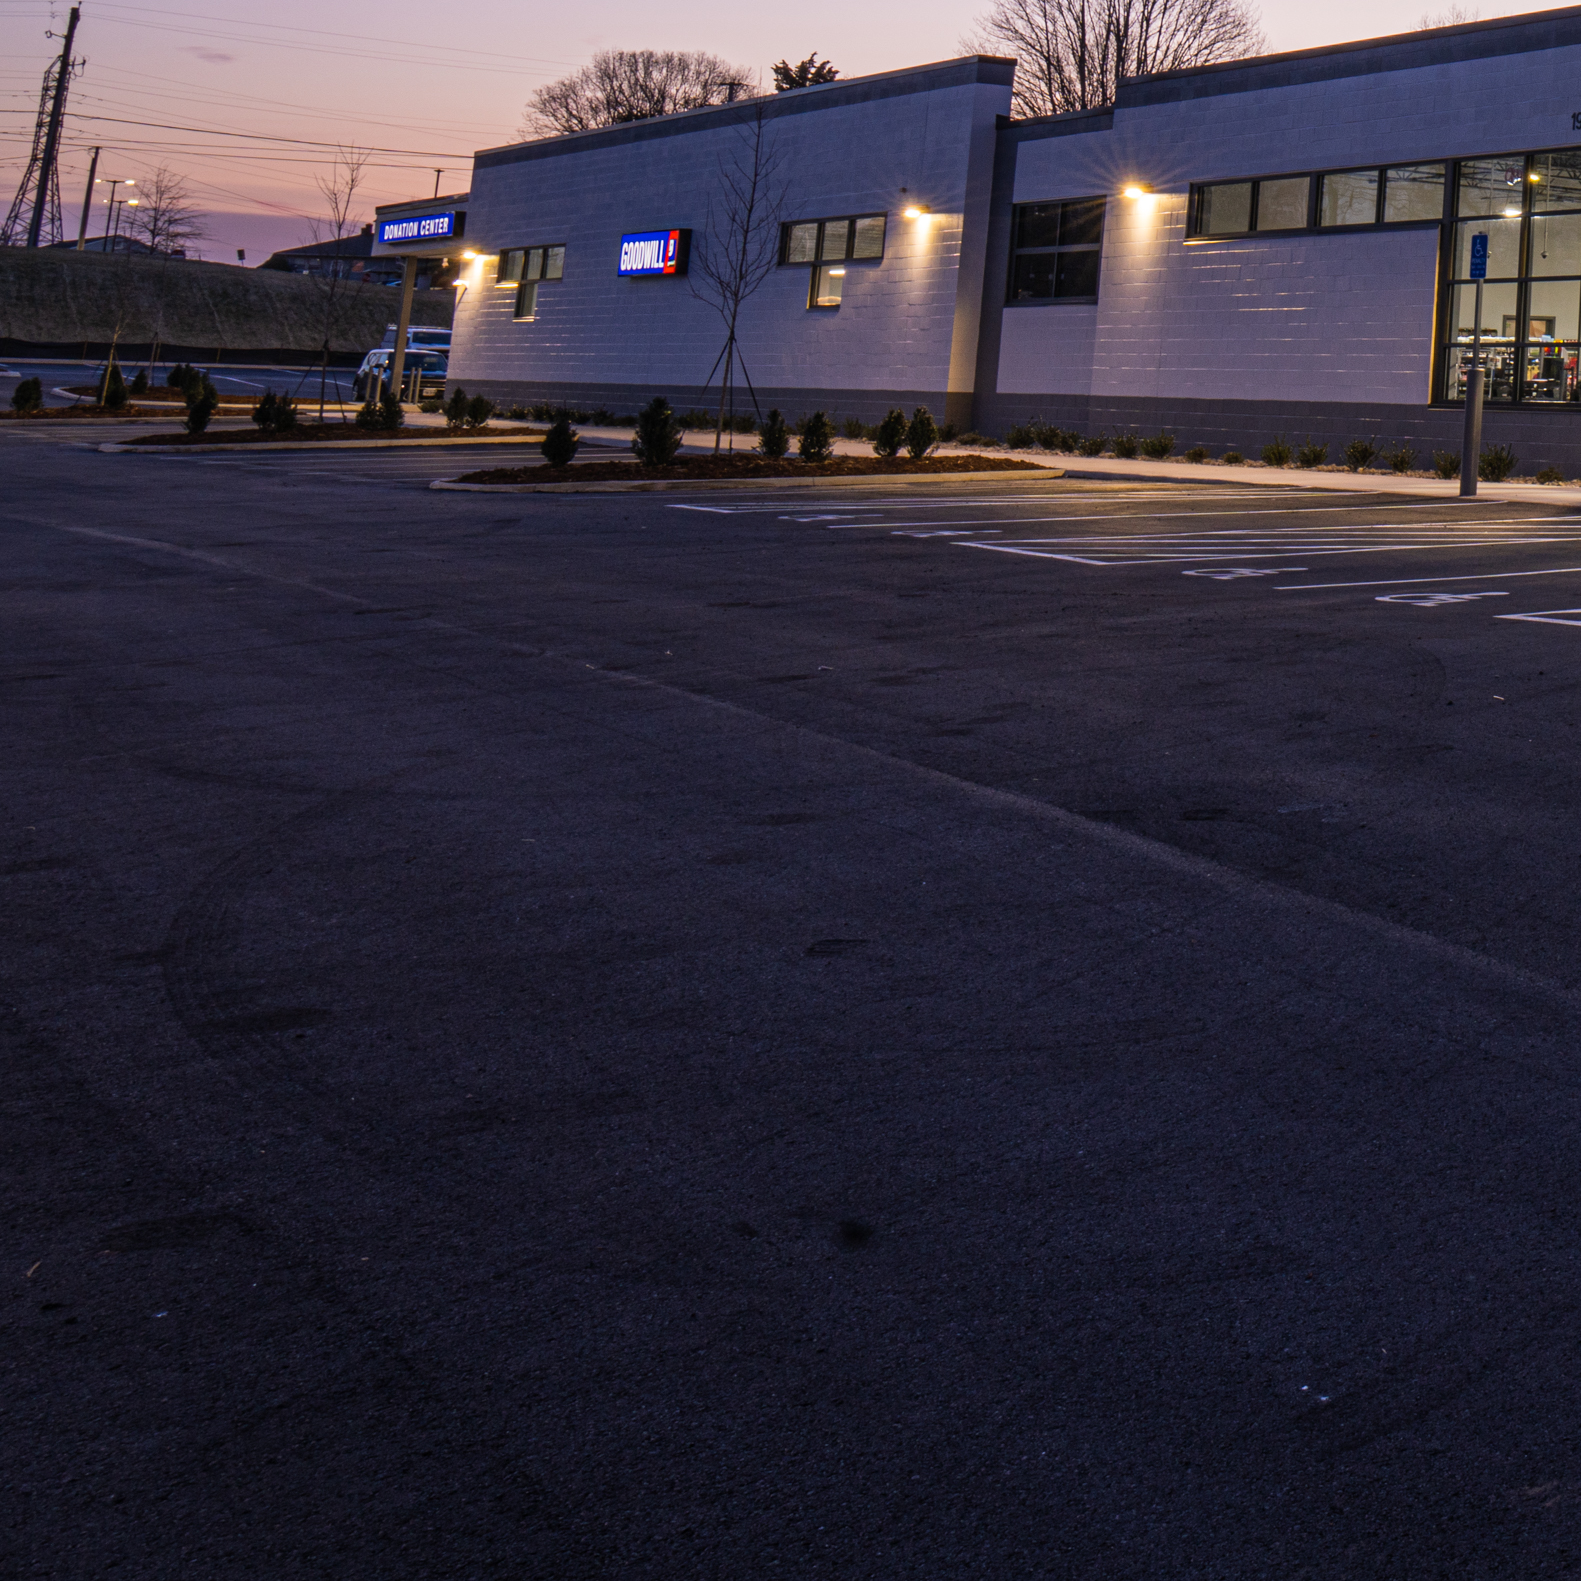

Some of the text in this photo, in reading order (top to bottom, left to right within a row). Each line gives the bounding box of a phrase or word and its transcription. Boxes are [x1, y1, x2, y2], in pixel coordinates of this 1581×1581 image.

[383, 217, 449, 240] DONATION CENTER
[620, 239, 665, 271] GOODWILL
